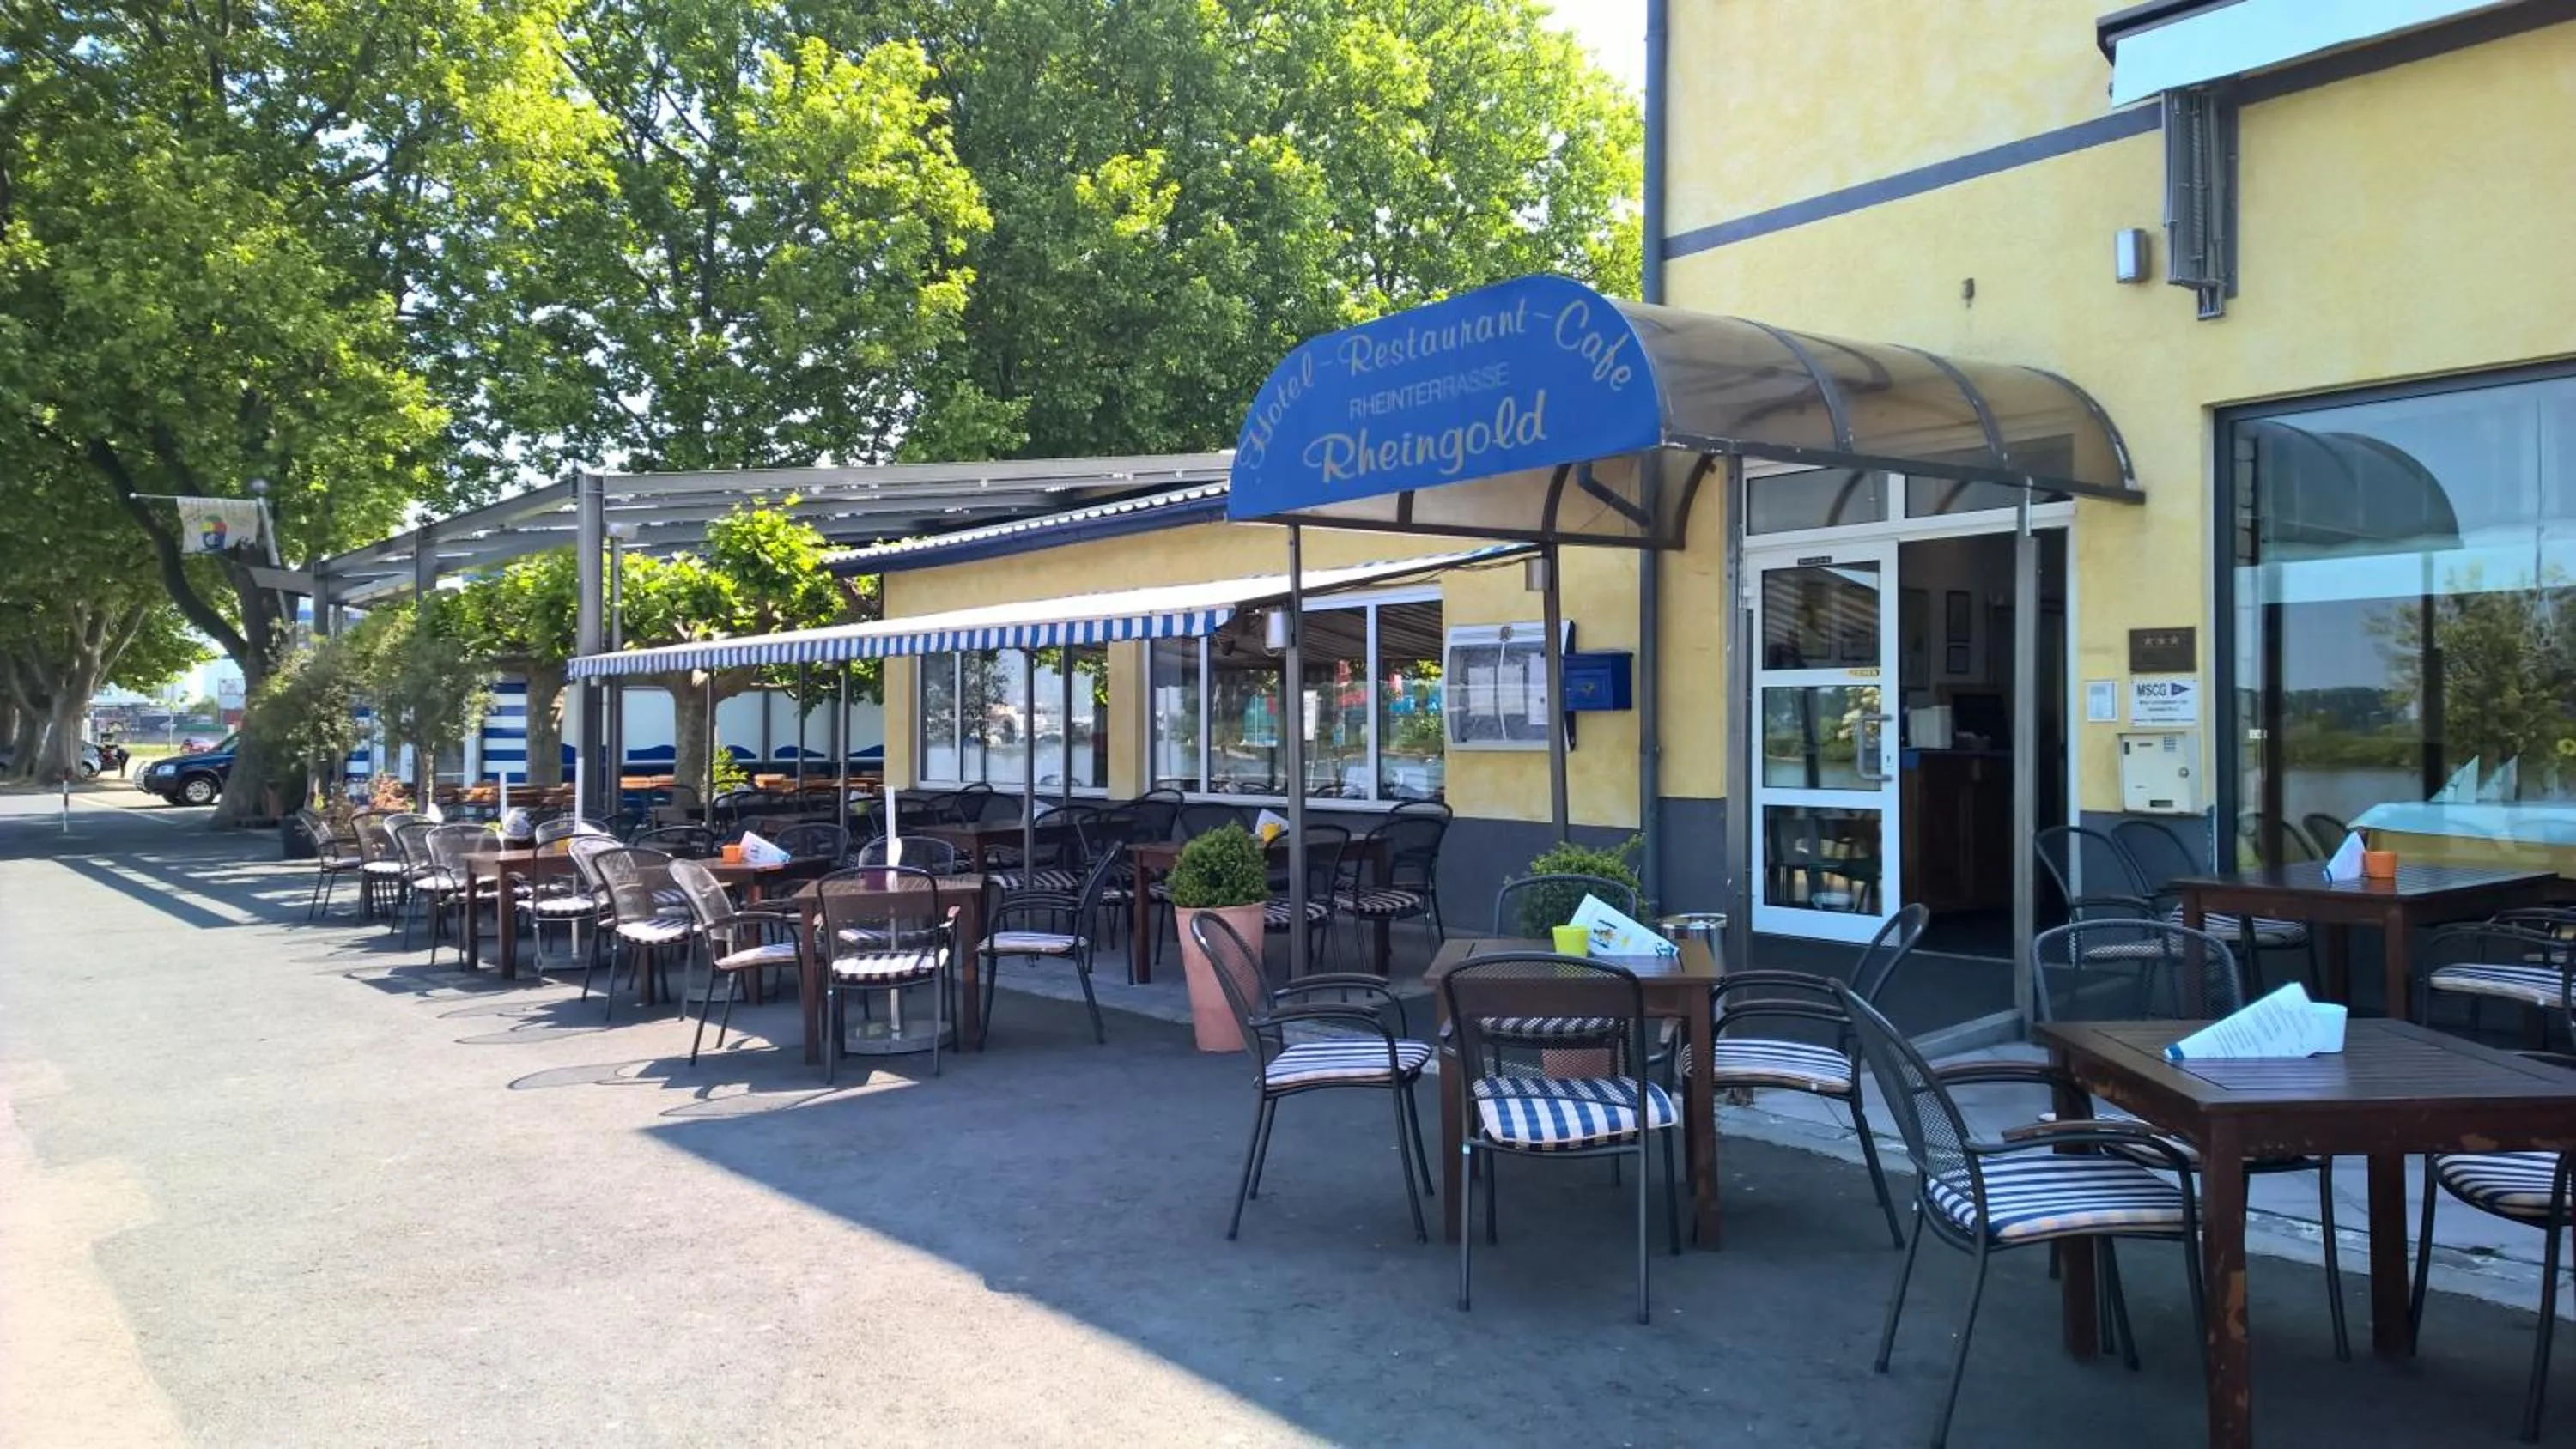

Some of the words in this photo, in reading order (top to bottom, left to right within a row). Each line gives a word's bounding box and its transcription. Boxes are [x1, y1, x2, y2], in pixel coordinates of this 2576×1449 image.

[1338, 297, 1528, 377] Restaurant
[1555, 300, 1631, 391] Cafe
[1349, 361, 1510, 421] RHEINTERRASSE
[1303, 389, 1547, 483] Rheingold
